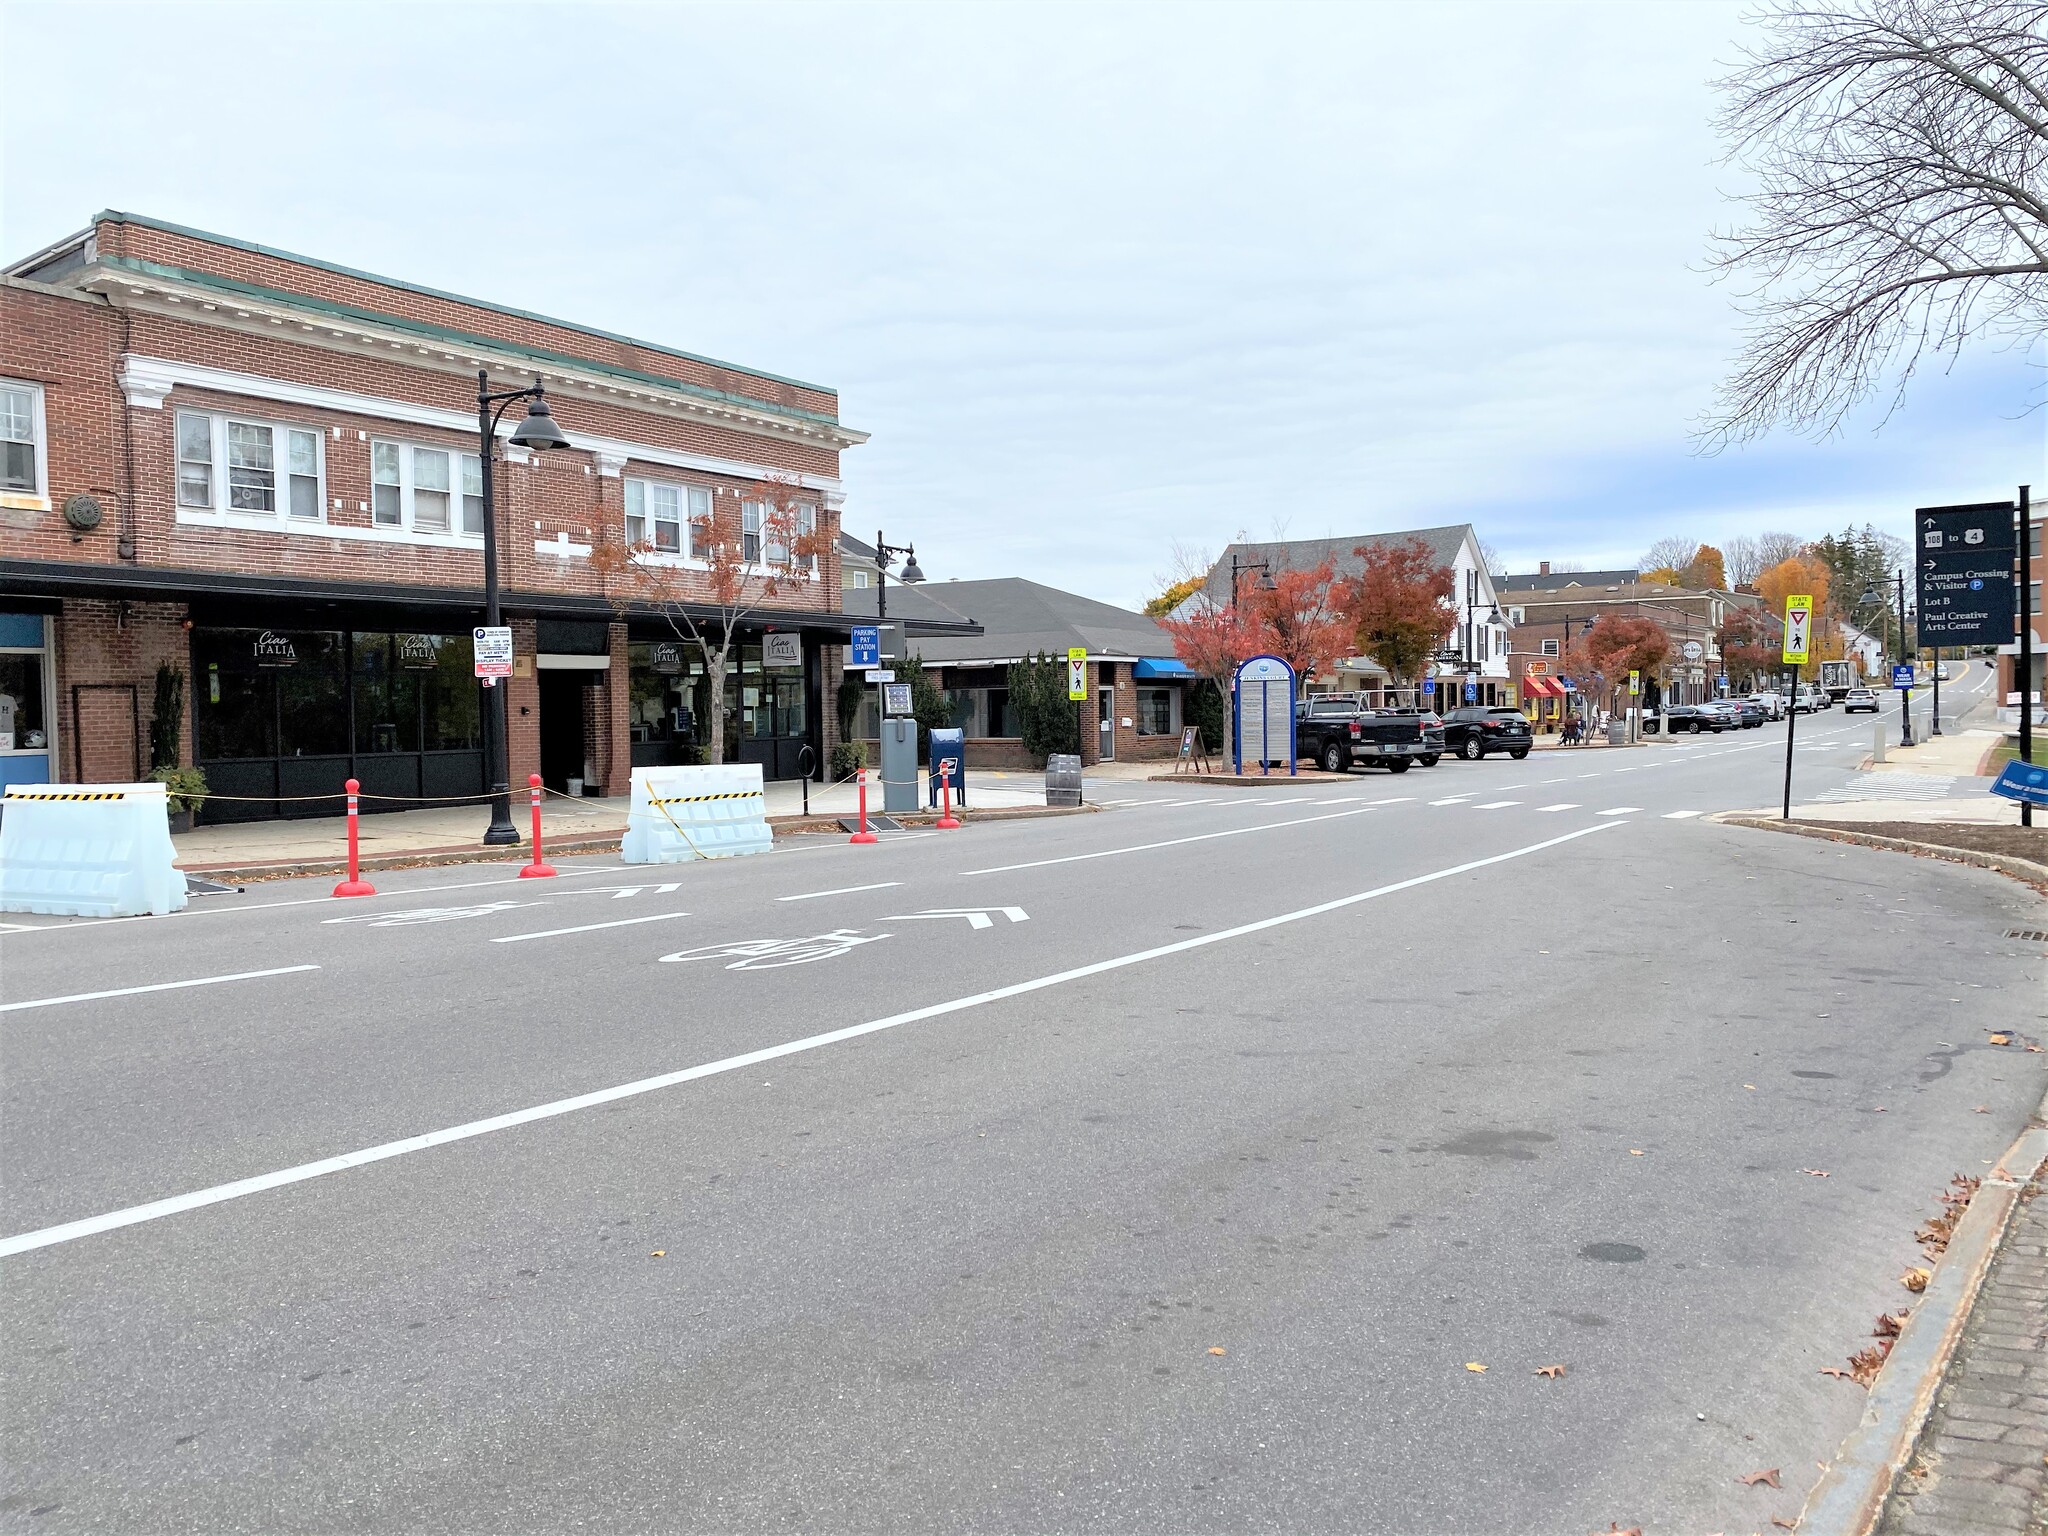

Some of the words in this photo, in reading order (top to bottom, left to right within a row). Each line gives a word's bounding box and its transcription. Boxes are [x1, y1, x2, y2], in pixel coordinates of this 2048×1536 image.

[1928, 535, 1941, 544] 108
[1970, 532, 1977, 540] 4
[1924, 572, 1963, 581] Campus
[1966, 570, 2009, 578] Crossing
[1924, 583, 1933, 591] &
[1935, 581, 1968, 590] Visitor
[1925, 598, 1941, 606] Lot
[1943, 597, 1951, 605] B
[1925, 612, 1946, 621] Paul
[1948, 611, 1989, 620] Creative
[1925, 623, 1946, 631] Arts
[1948, 622, 1981, 630] Center
[259, 630, 290, 645] Ciao
[405, 635, 429, 648] Ciao
[771, 635, 791, 647] Ciao
[253, 642, 296, 657] ITALIA
[400, 647, 436, 660] ITALIA
[657, 643, 676, 654] Ciao
[767, 645, 795, 657] ITALIA
[653, 652, 680, 664] ITALIA
